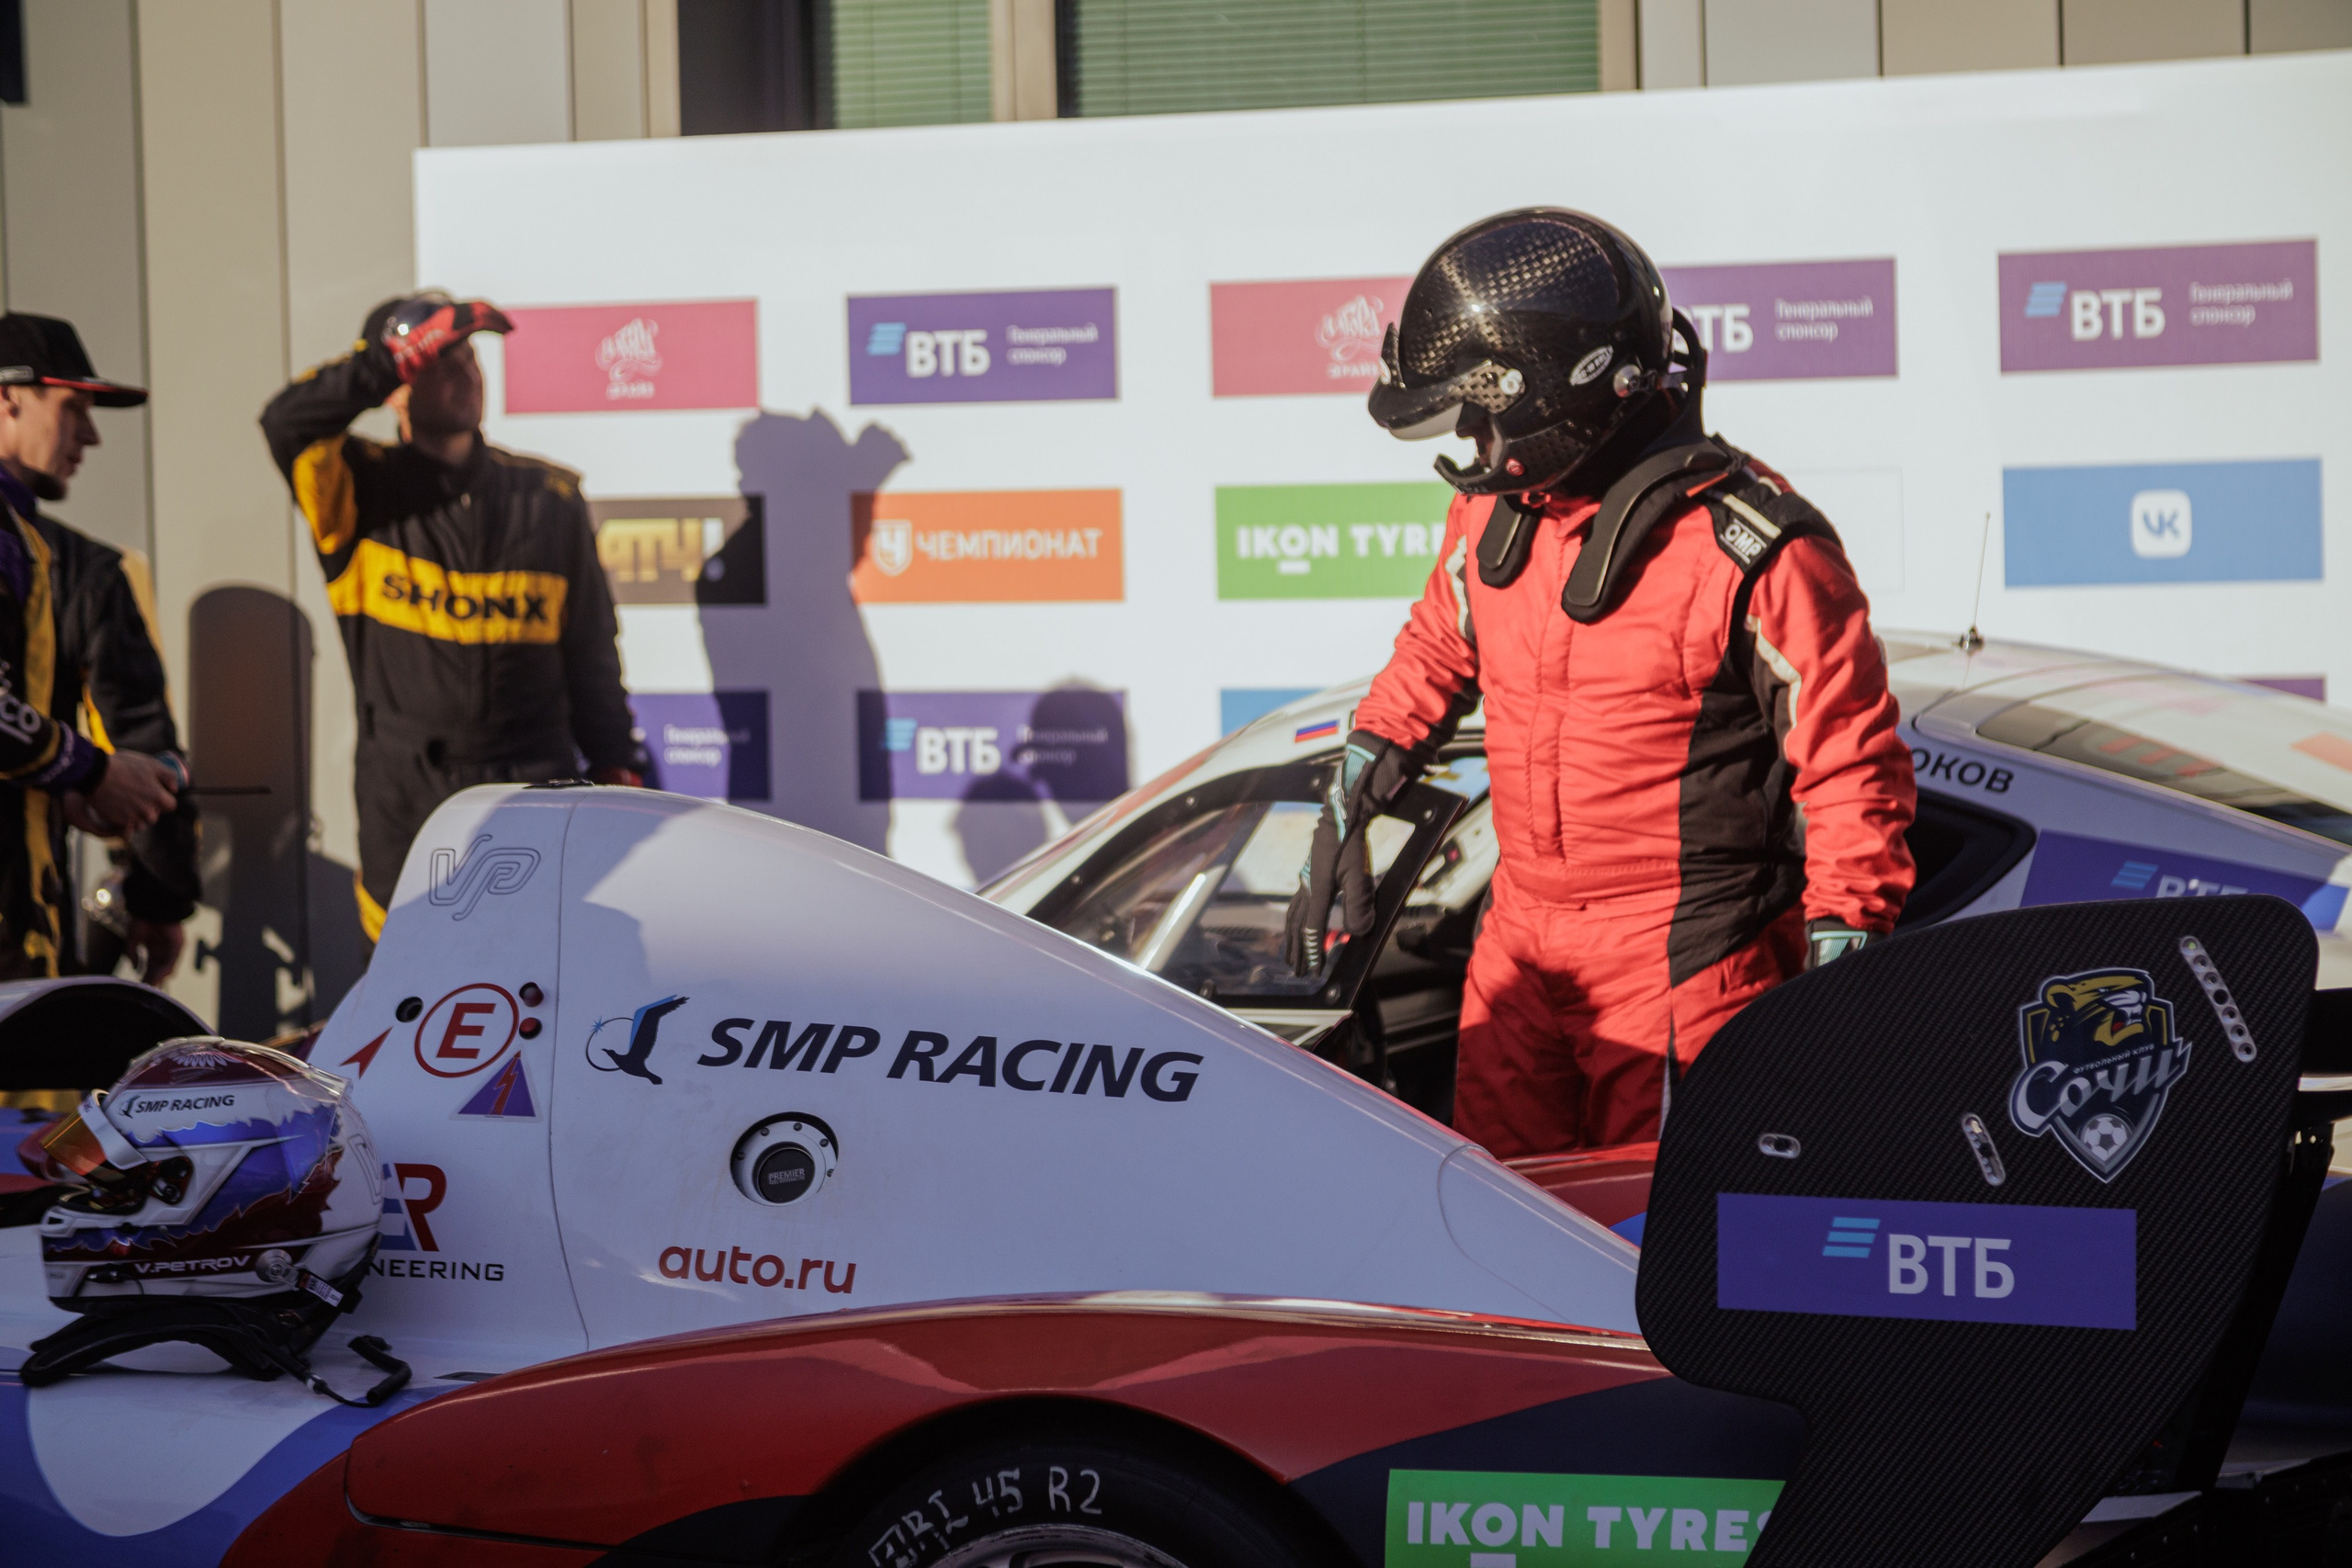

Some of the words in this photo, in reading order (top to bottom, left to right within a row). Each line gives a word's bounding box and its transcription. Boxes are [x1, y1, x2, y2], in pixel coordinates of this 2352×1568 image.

[1775, 296, 1873, 321] Генеральный
[2071, 287, 2166, 342] ВТБ
[905, 329, 990, 378] ВТБ
[1775, 321, 1838, 344] спонсор
[917, 527, 1102, 560] ЧЕМПИОНАТ
[1238, 525, 1339, 558] IKON
[1724, 523, 1762, 557] OMP
[382, 573, 548, 623] SHONX
[916, 727, 1001, 775] ВТБ
[1911, 748, 2014, 794] ОКОВ
[435, 1002, 497, 1060] E
[696, 1017, 882, 1074] SMP
[886, 1030, 1204, 1102] RACING
[135, 1100, 169, 1114] SMP
[170, 1094, 235, 1111] RACING
[769, 1168, 805, 1182] PREMIER
[368, 1258, 504, 1282] NEERING
[659, 1246, 856, 1294] auto.ru
[1888, 1233, 2016, 1299] ВТБ
[971, 1468, 1023, 1518] 45
[1049, 1466, 1102, 1515] R2
[1408, 1501, 1565, 1548] IKON
